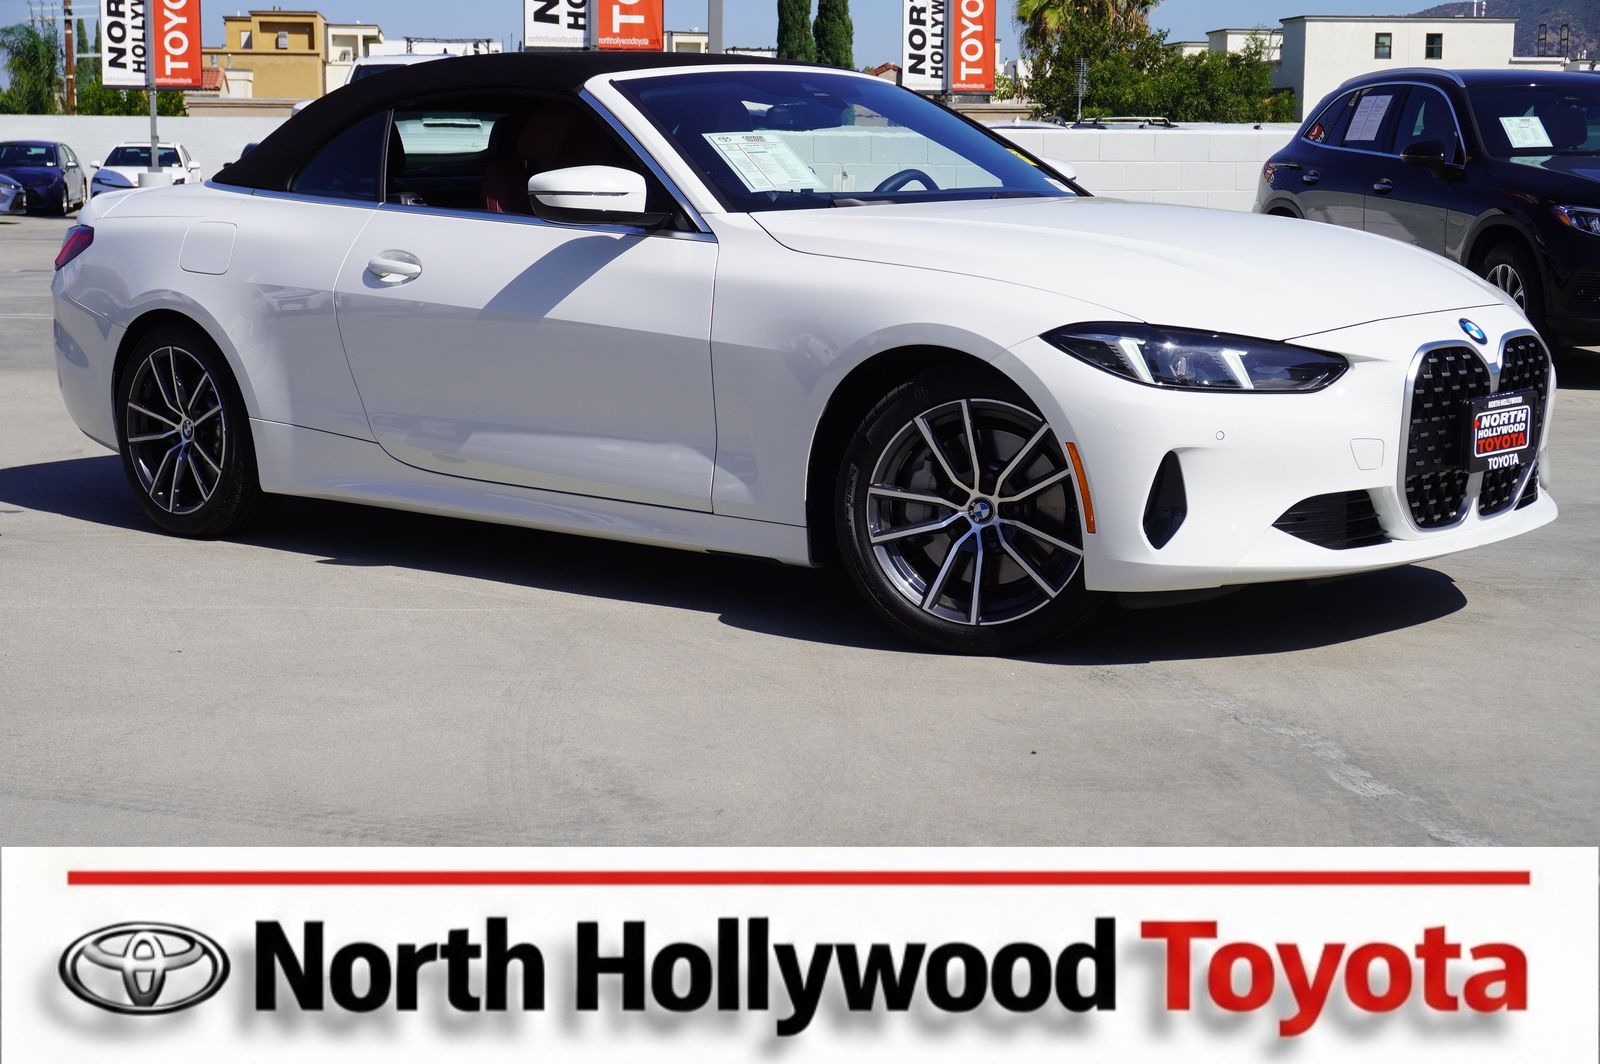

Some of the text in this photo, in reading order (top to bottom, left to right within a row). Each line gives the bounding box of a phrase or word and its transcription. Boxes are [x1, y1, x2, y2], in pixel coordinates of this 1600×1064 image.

[612, 0, 645, 33] T
[908, 0, 927, 75] NOR
[960, 0, 984, 80] TOYO
[1481, 409, 1527, 428] NORTH
[1478, 423, 1526, 439] HOLLYWOOD
[1478, 432, 1525, 453] TOYOTA
[1488, 453, 1519, 470] TOYOTA
